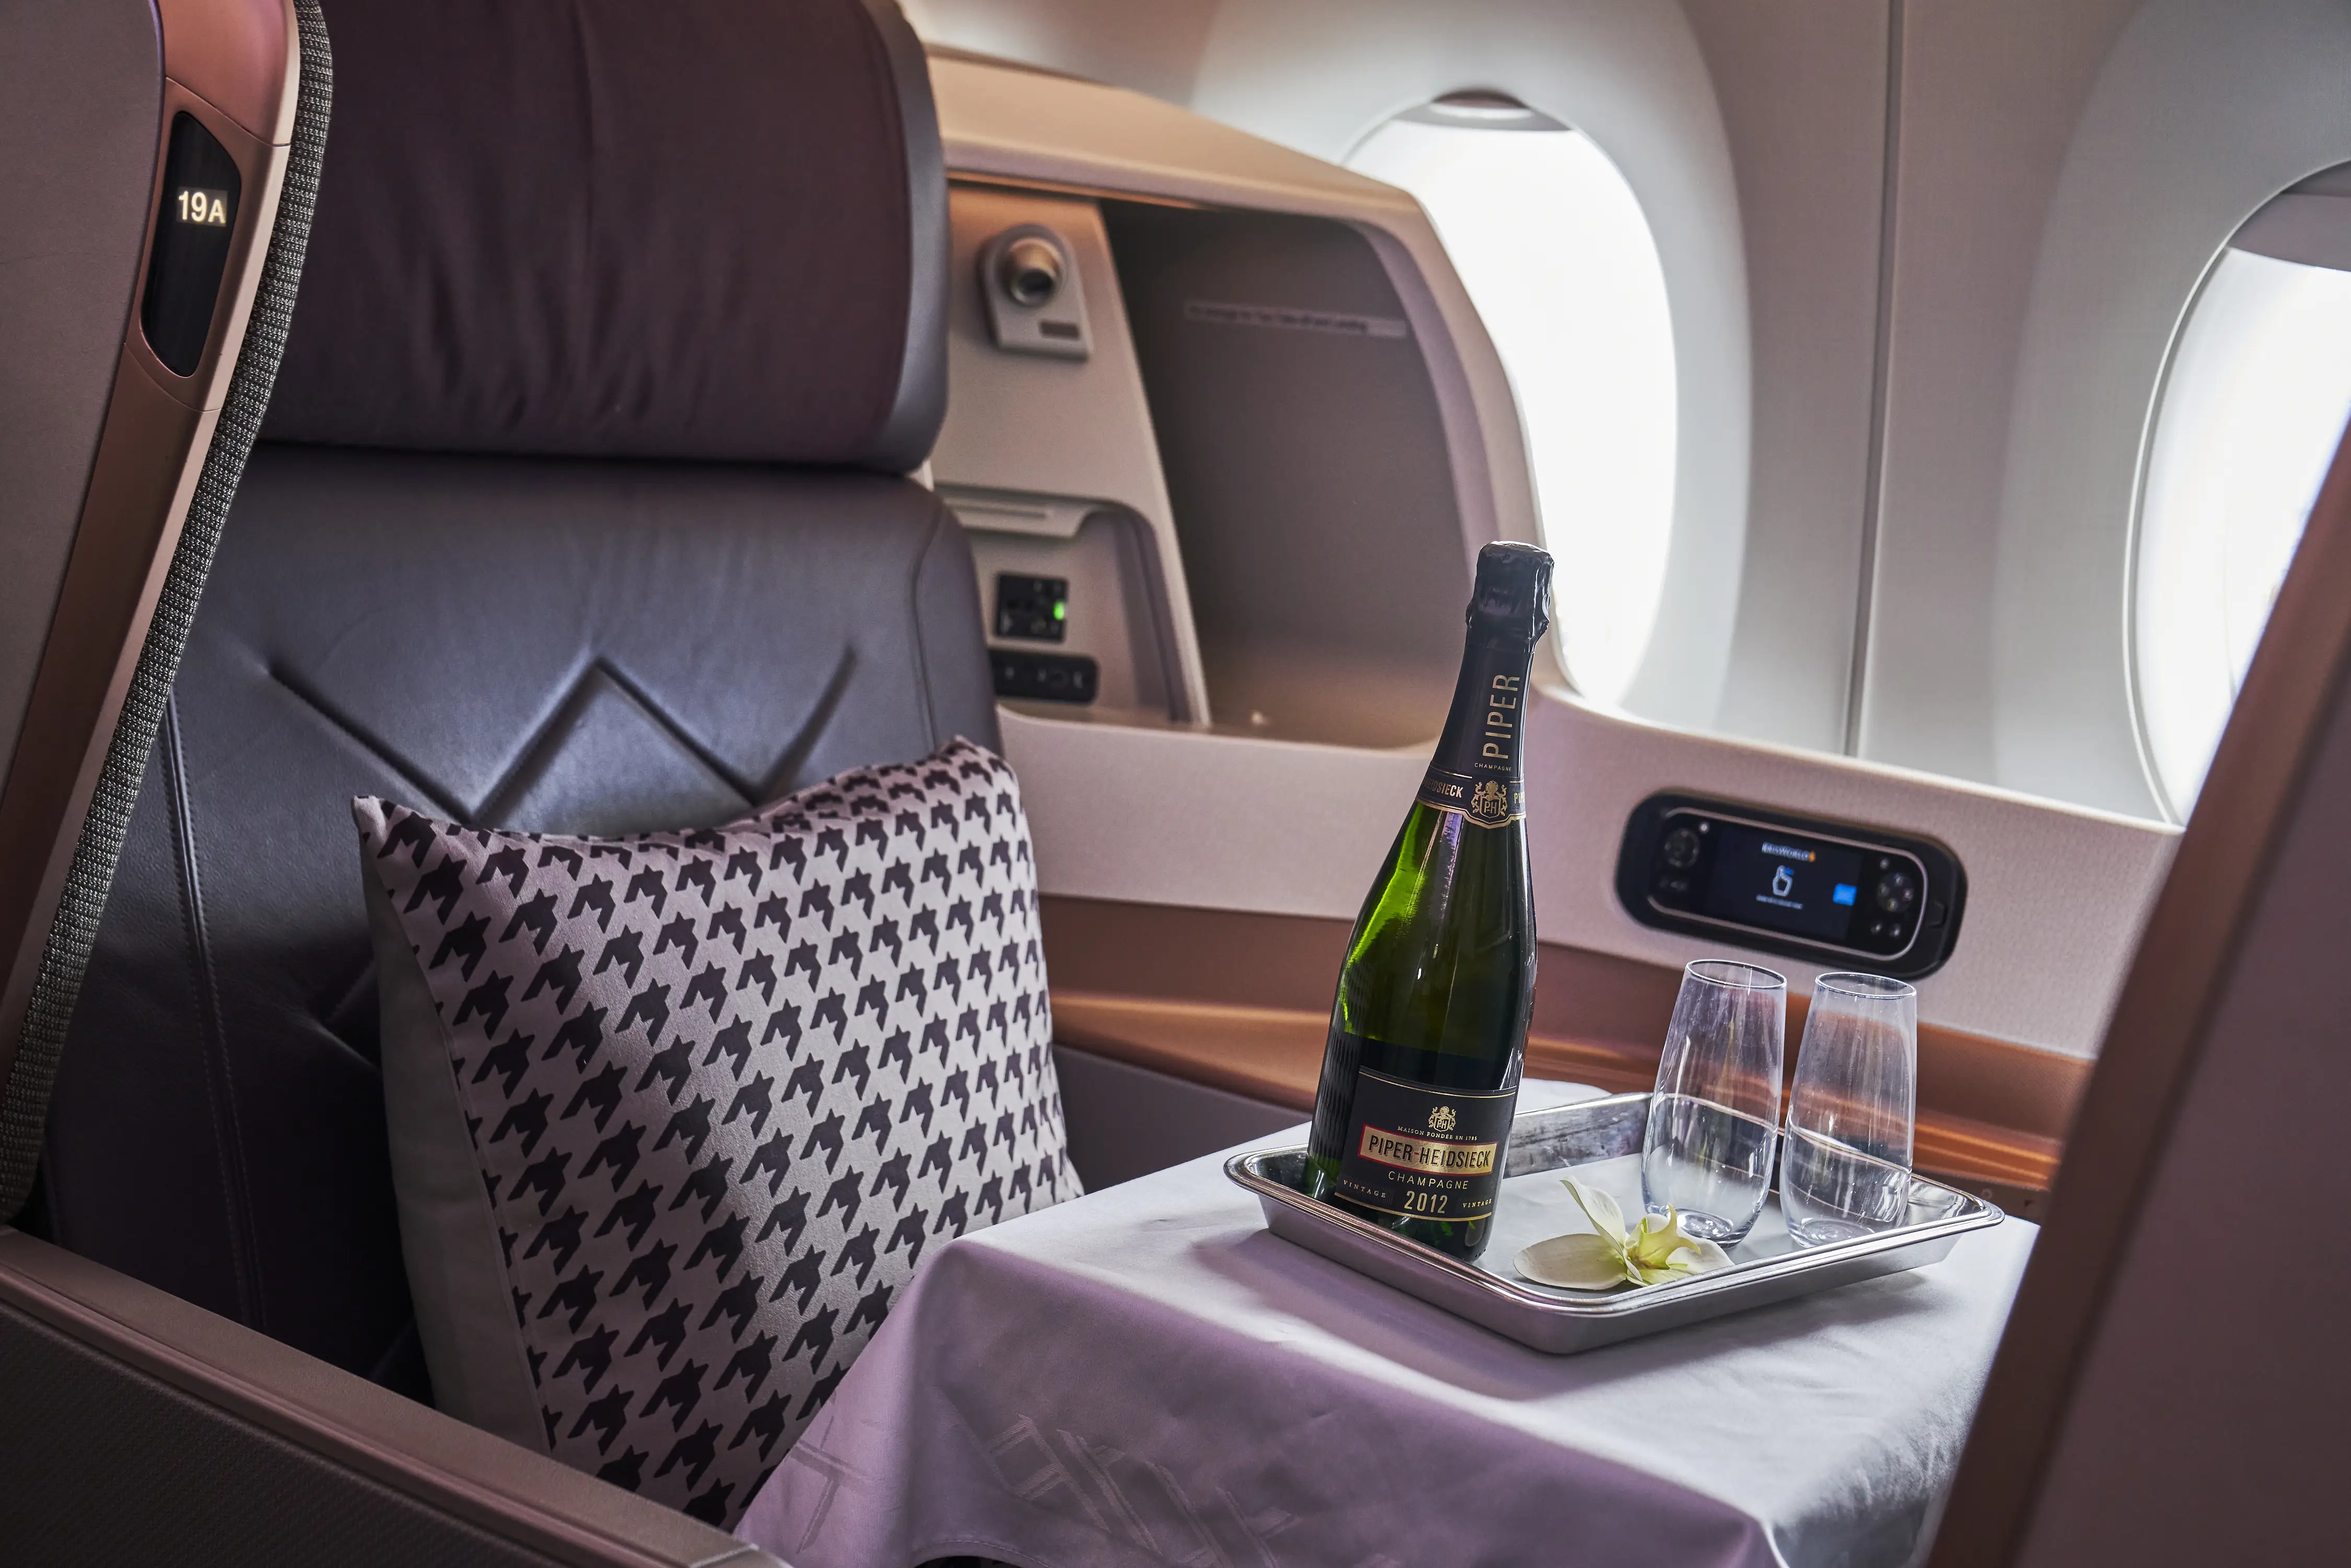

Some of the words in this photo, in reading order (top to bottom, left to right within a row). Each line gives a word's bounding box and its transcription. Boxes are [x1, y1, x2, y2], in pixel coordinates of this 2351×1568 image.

[179, 190, 226, 224] 19A
[1482, 675, 1520, 759] PIPER
[1474, 763, 1512, 772] CHAMPAGNE
[1397, 1126, 1424, 1136] MAISON
[1369, 1135, 1491, 1168] PIPER-HEIDSIECK
[1343, 1179, 1386, 1198] VINTAGE
[1388, 1171, 1469, 1189] CHAMPAGNE
[1404, 1190, 1448, 1214] 2012
[1463, 1198, 1492, 1208] VINTAGE
